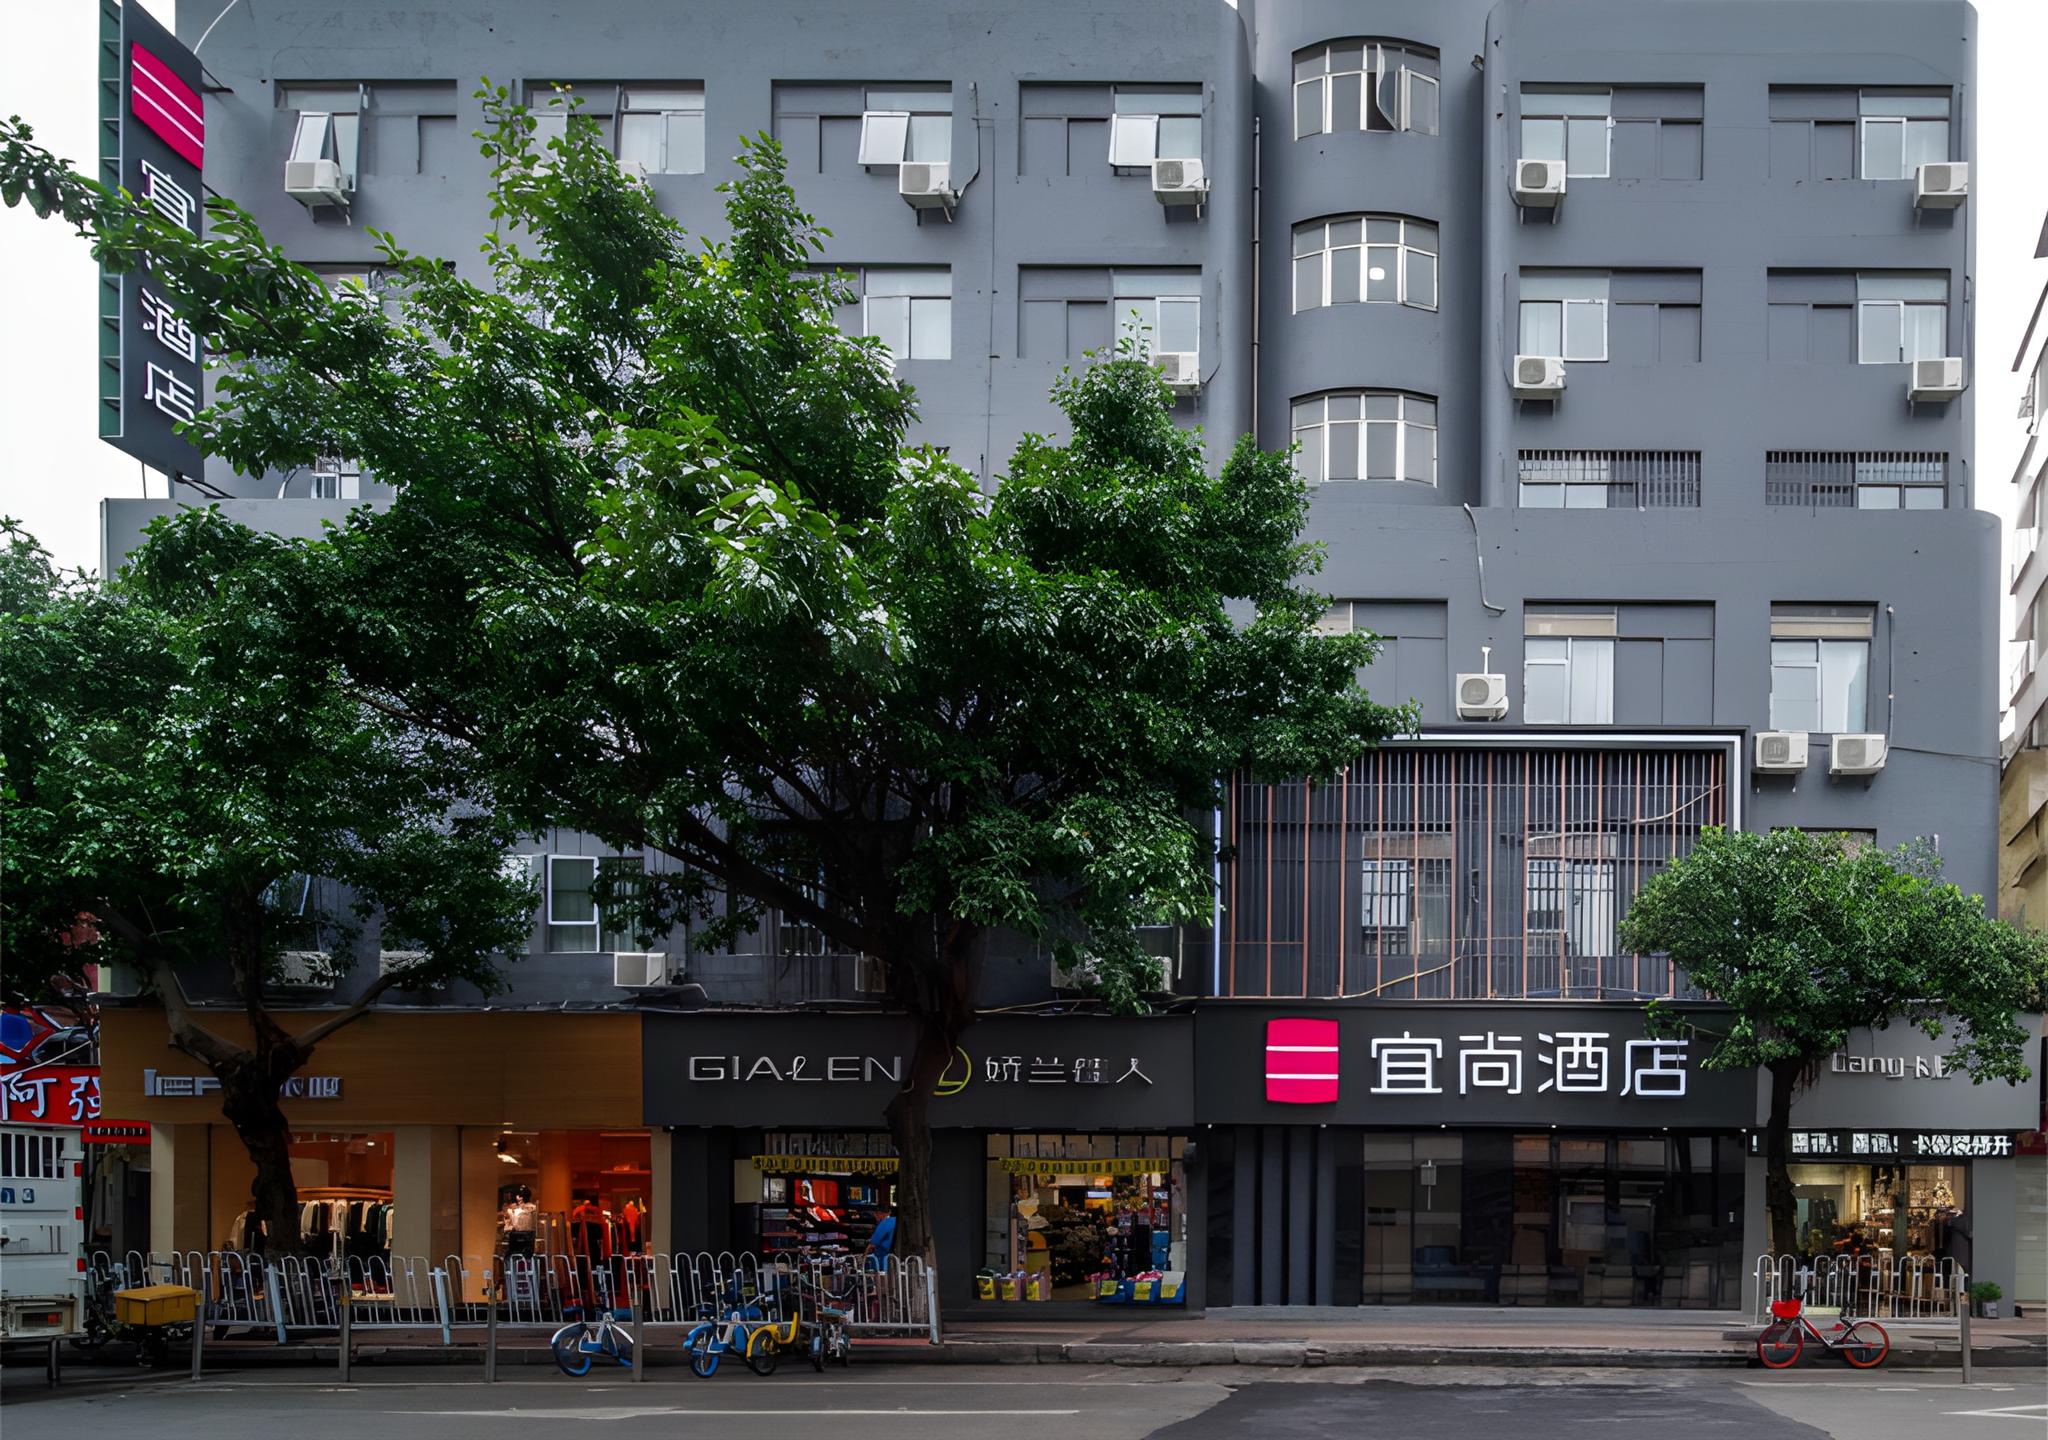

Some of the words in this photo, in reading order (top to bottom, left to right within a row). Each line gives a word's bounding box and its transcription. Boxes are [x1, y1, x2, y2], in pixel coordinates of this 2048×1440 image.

[141, 158, 197, 427] 宜酒店
[689, 1055, 902, 1082] GIALEN
[1370, 1030, 1689, 1097] 宜尚酒店
